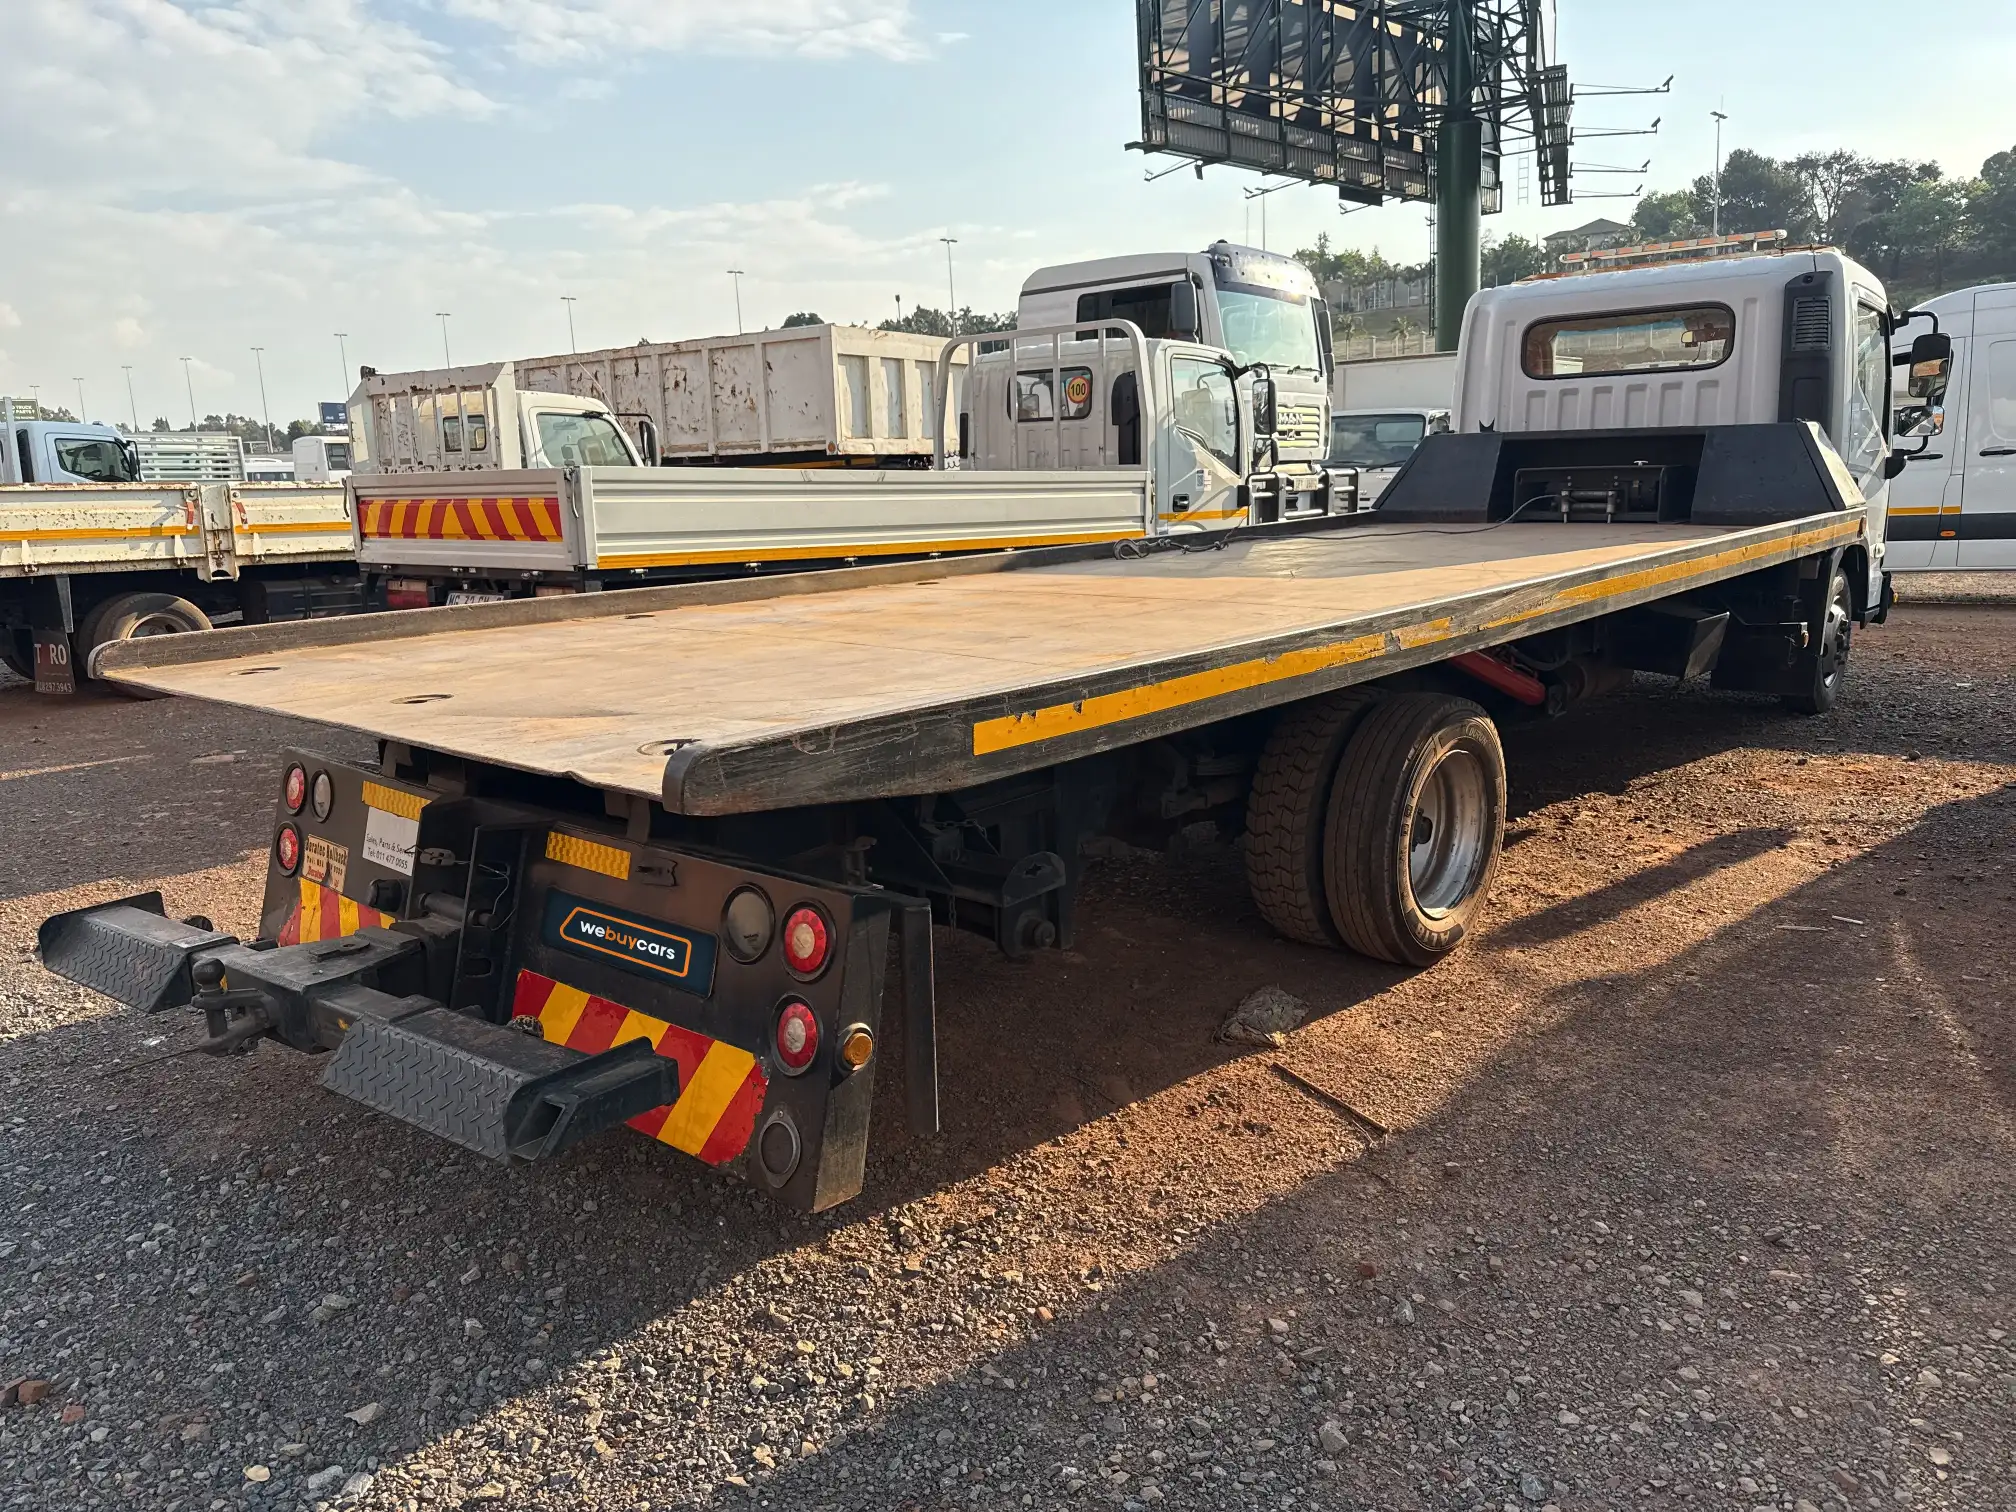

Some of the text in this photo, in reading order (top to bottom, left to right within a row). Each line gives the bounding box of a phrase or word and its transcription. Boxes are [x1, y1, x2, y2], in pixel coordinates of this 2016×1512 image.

[1070, 382, 1086, 397] 100
[1277, 412, 1304, 426] MAN
[379, 837, 391, 851] Parts
[395, 857, 408, 870] 0055
[580, 920, 676, 960] webuycars
